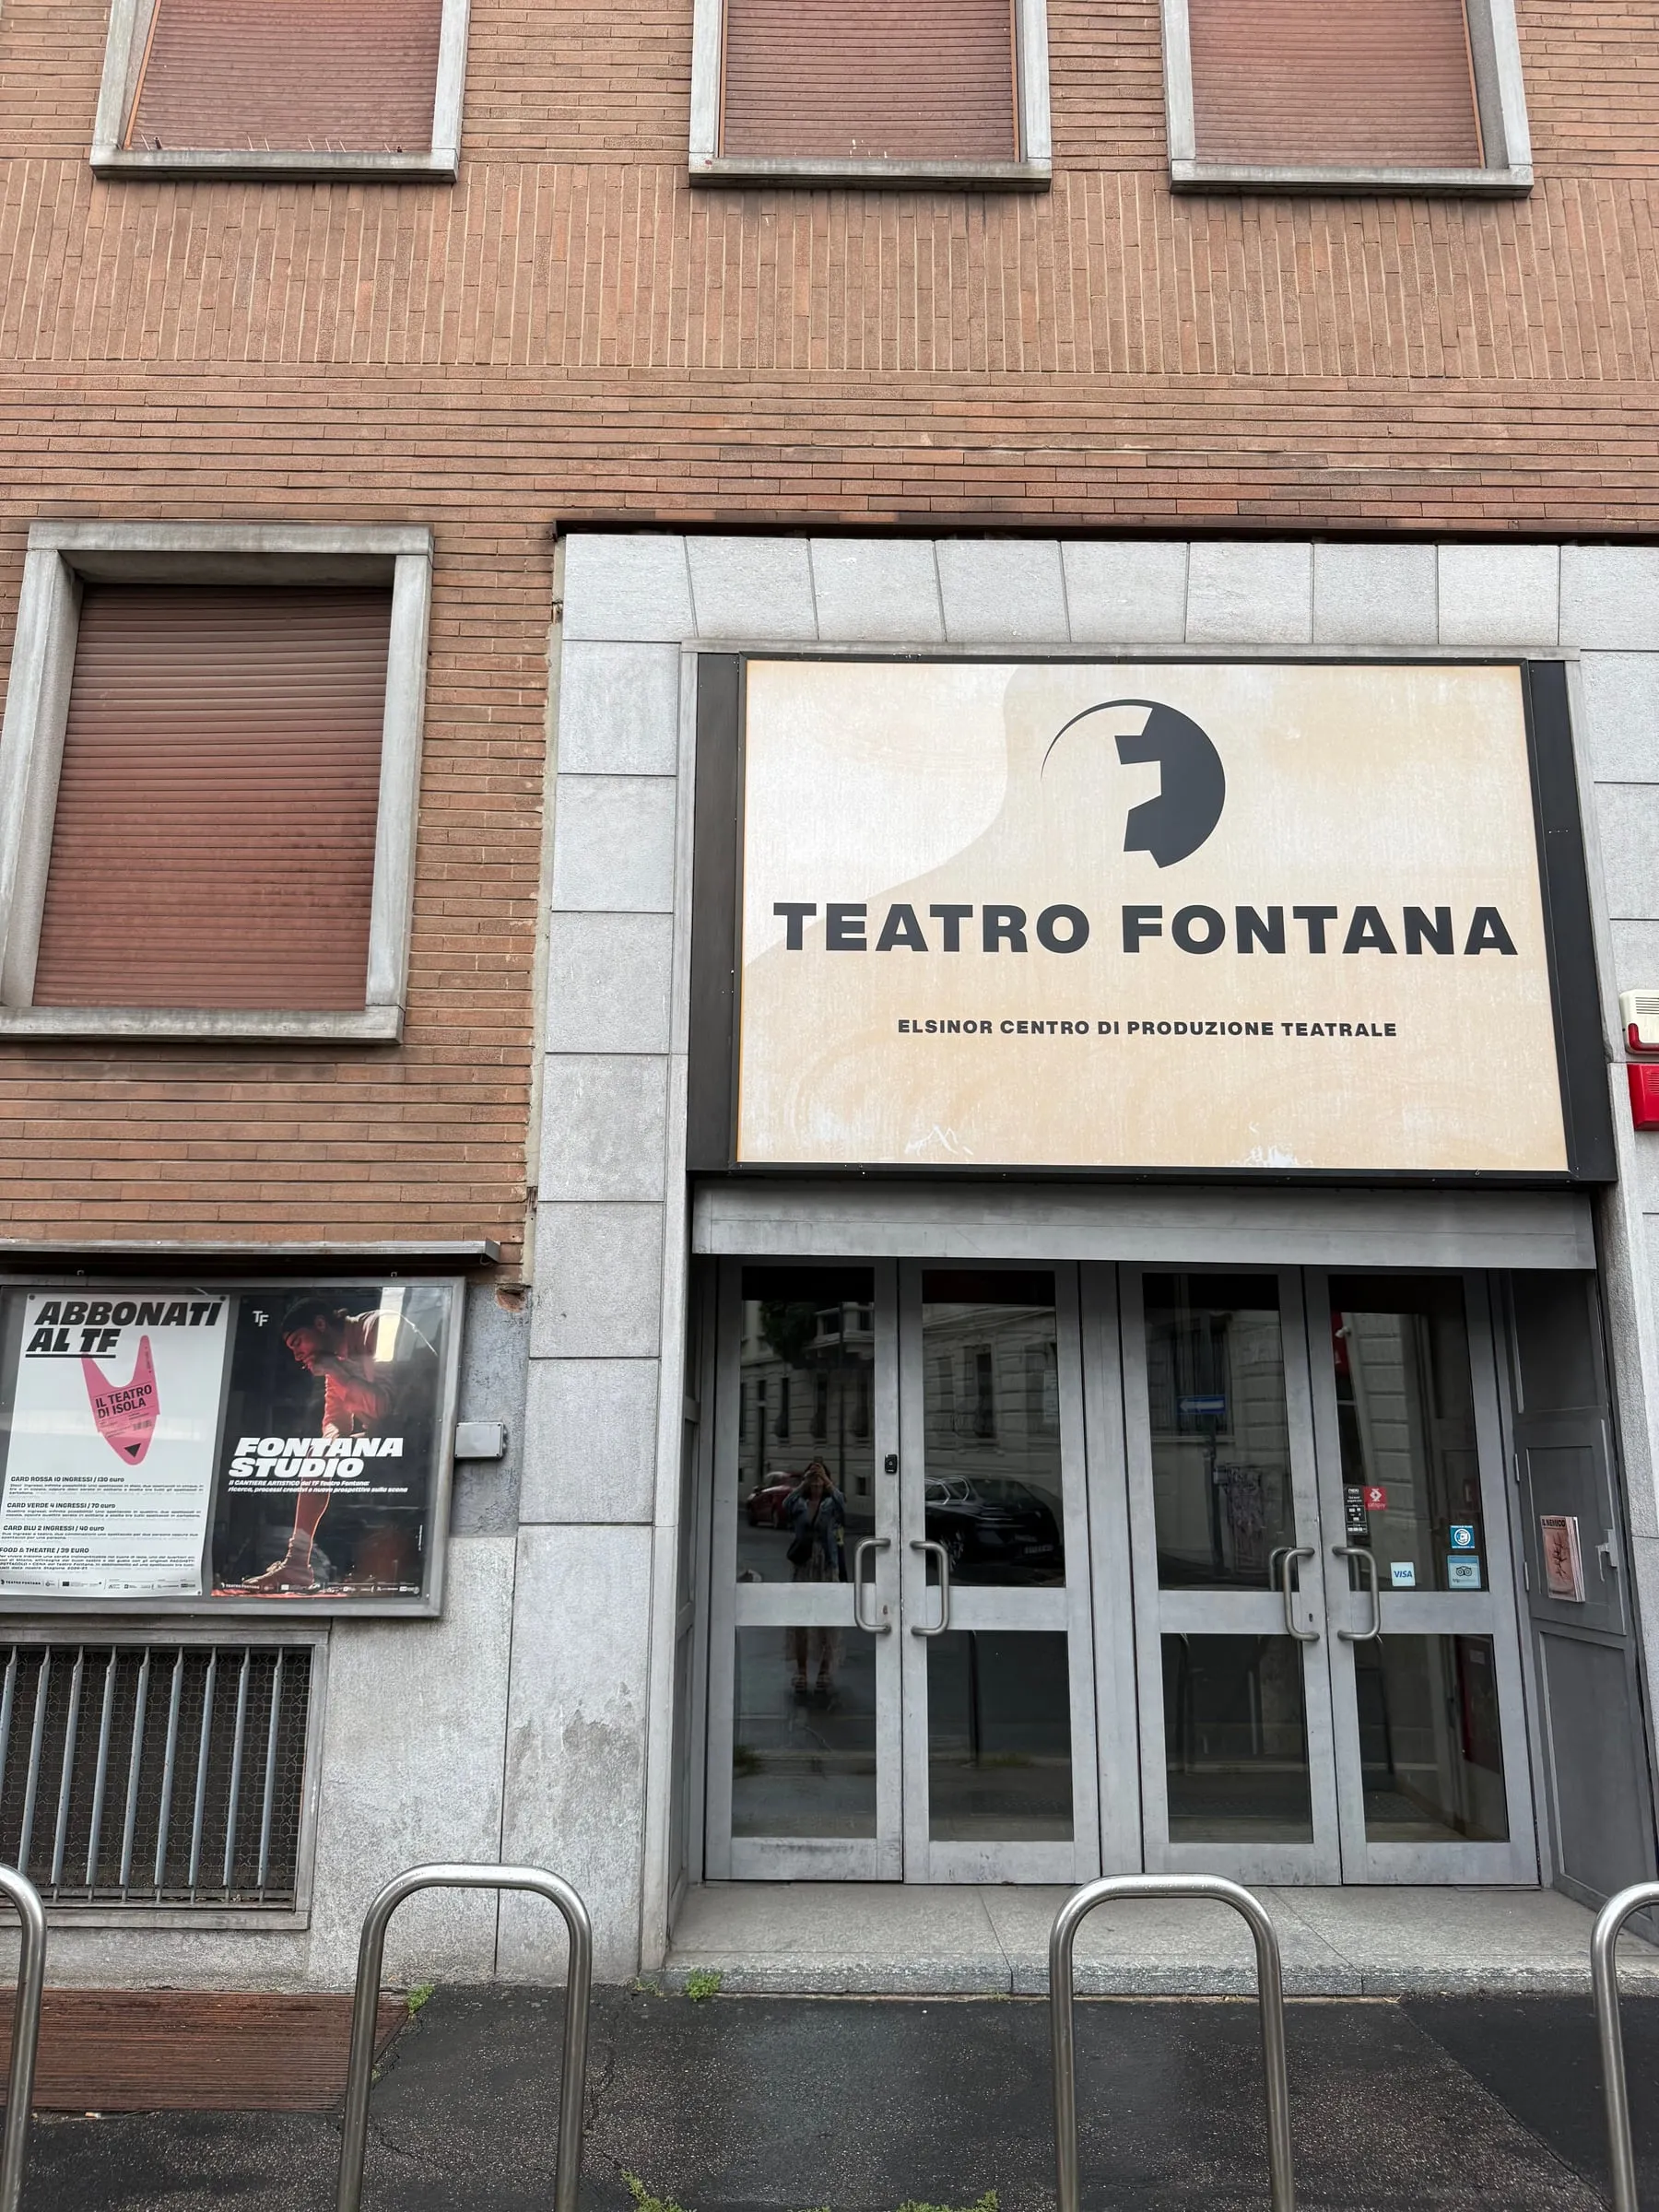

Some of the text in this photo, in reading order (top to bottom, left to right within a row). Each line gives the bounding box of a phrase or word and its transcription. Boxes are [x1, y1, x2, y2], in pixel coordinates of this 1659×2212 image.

[773, 902, 1519, 956] TEATRO FONTANA
[898, 1019, 1397, 1037] ELSINOR CENTRO DI PRODUZIONE TEATRALE
[34, 1301, 223, 1326] ABBONATI
[253, 1311, 269, 1327] TF
[27, 1328, 122, 1352] AL TF
[95, 1384, 152, 1408] IL TEATRO
[97, 1397, 147, 1418] DI ISOLA
[234, 1437, 404, 1457] FONTANA
[228, 1458, 364, 1478] STUDIO
